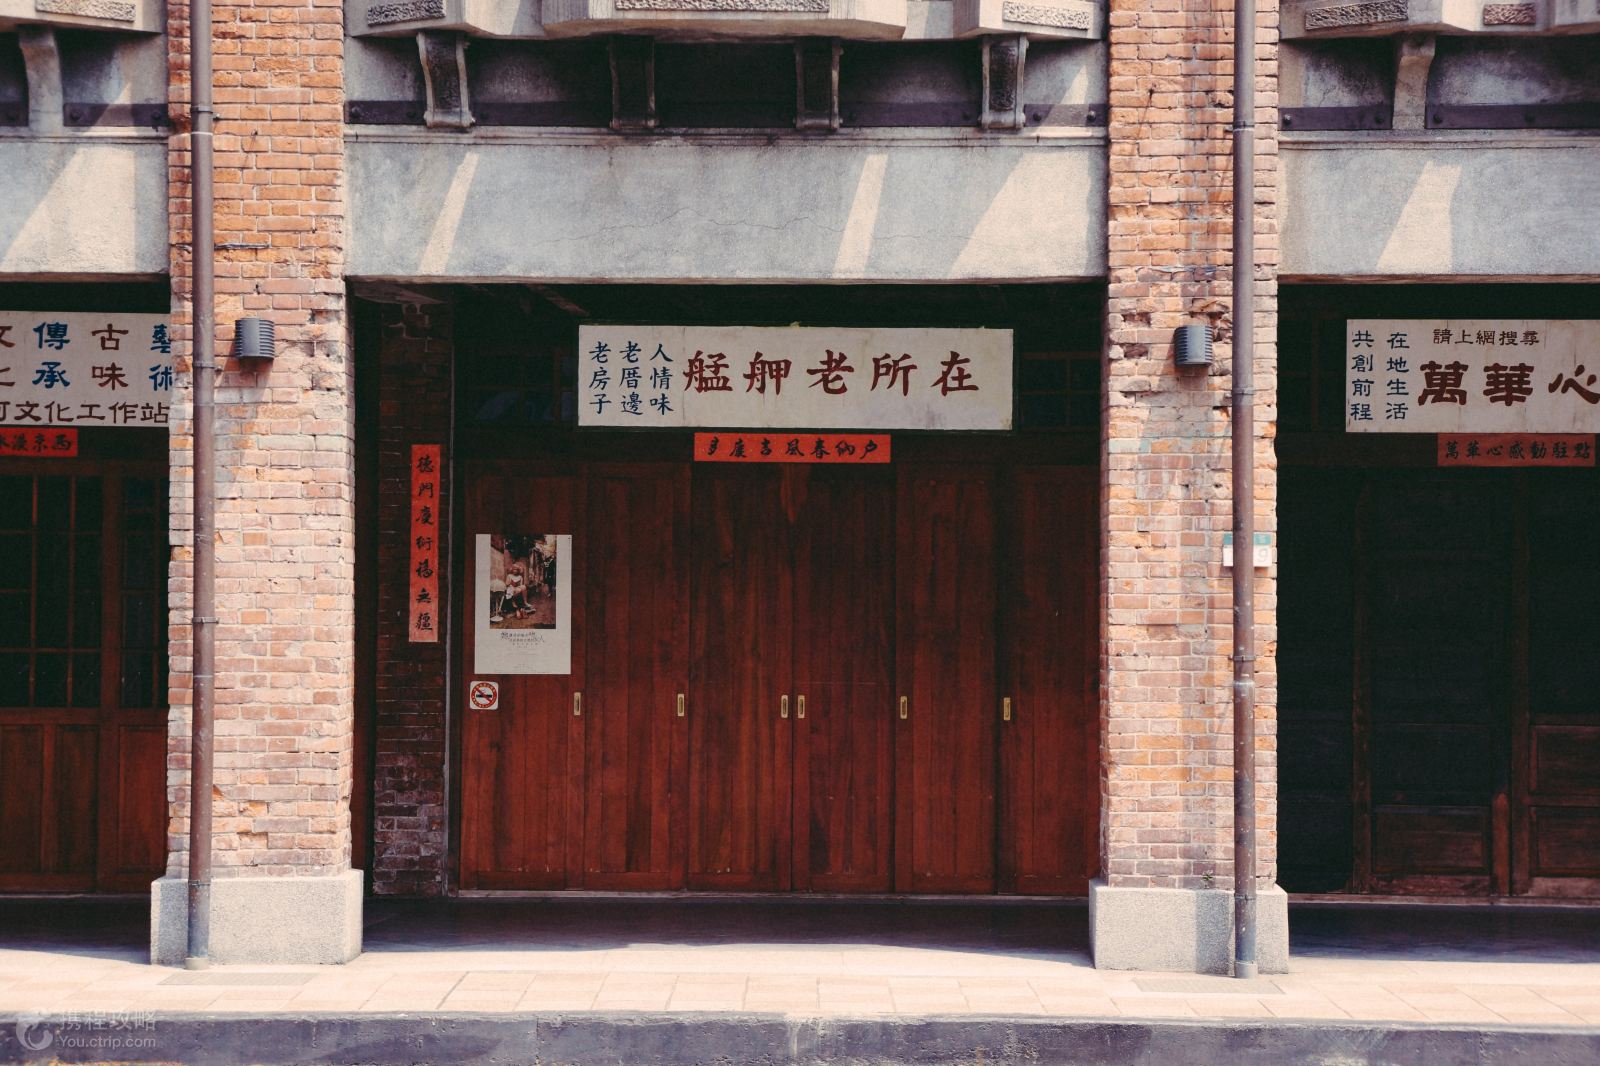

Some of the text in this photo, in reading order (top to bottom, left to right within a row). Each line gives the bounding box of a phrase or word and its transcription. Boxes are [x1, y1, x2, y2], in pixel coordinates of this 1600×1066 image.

[32, 321, 71, 389] 傳承
[91, 323, 129, 390] 古味
[1432, 328, 1541, 346] 請上網搜尋
[589, 341, 612, 415] 老房子
[619, 340, 643, 416] 老厝邊
[649, 342, 674, 416] 人情味
[682, 349, 980, 397] 艋舺老所在
[1350, 329, 1375, 422] 共創前程
[1385, 331, 1410, 421] 在地生活
[1417, 360, 1600, 407] 萬華心
